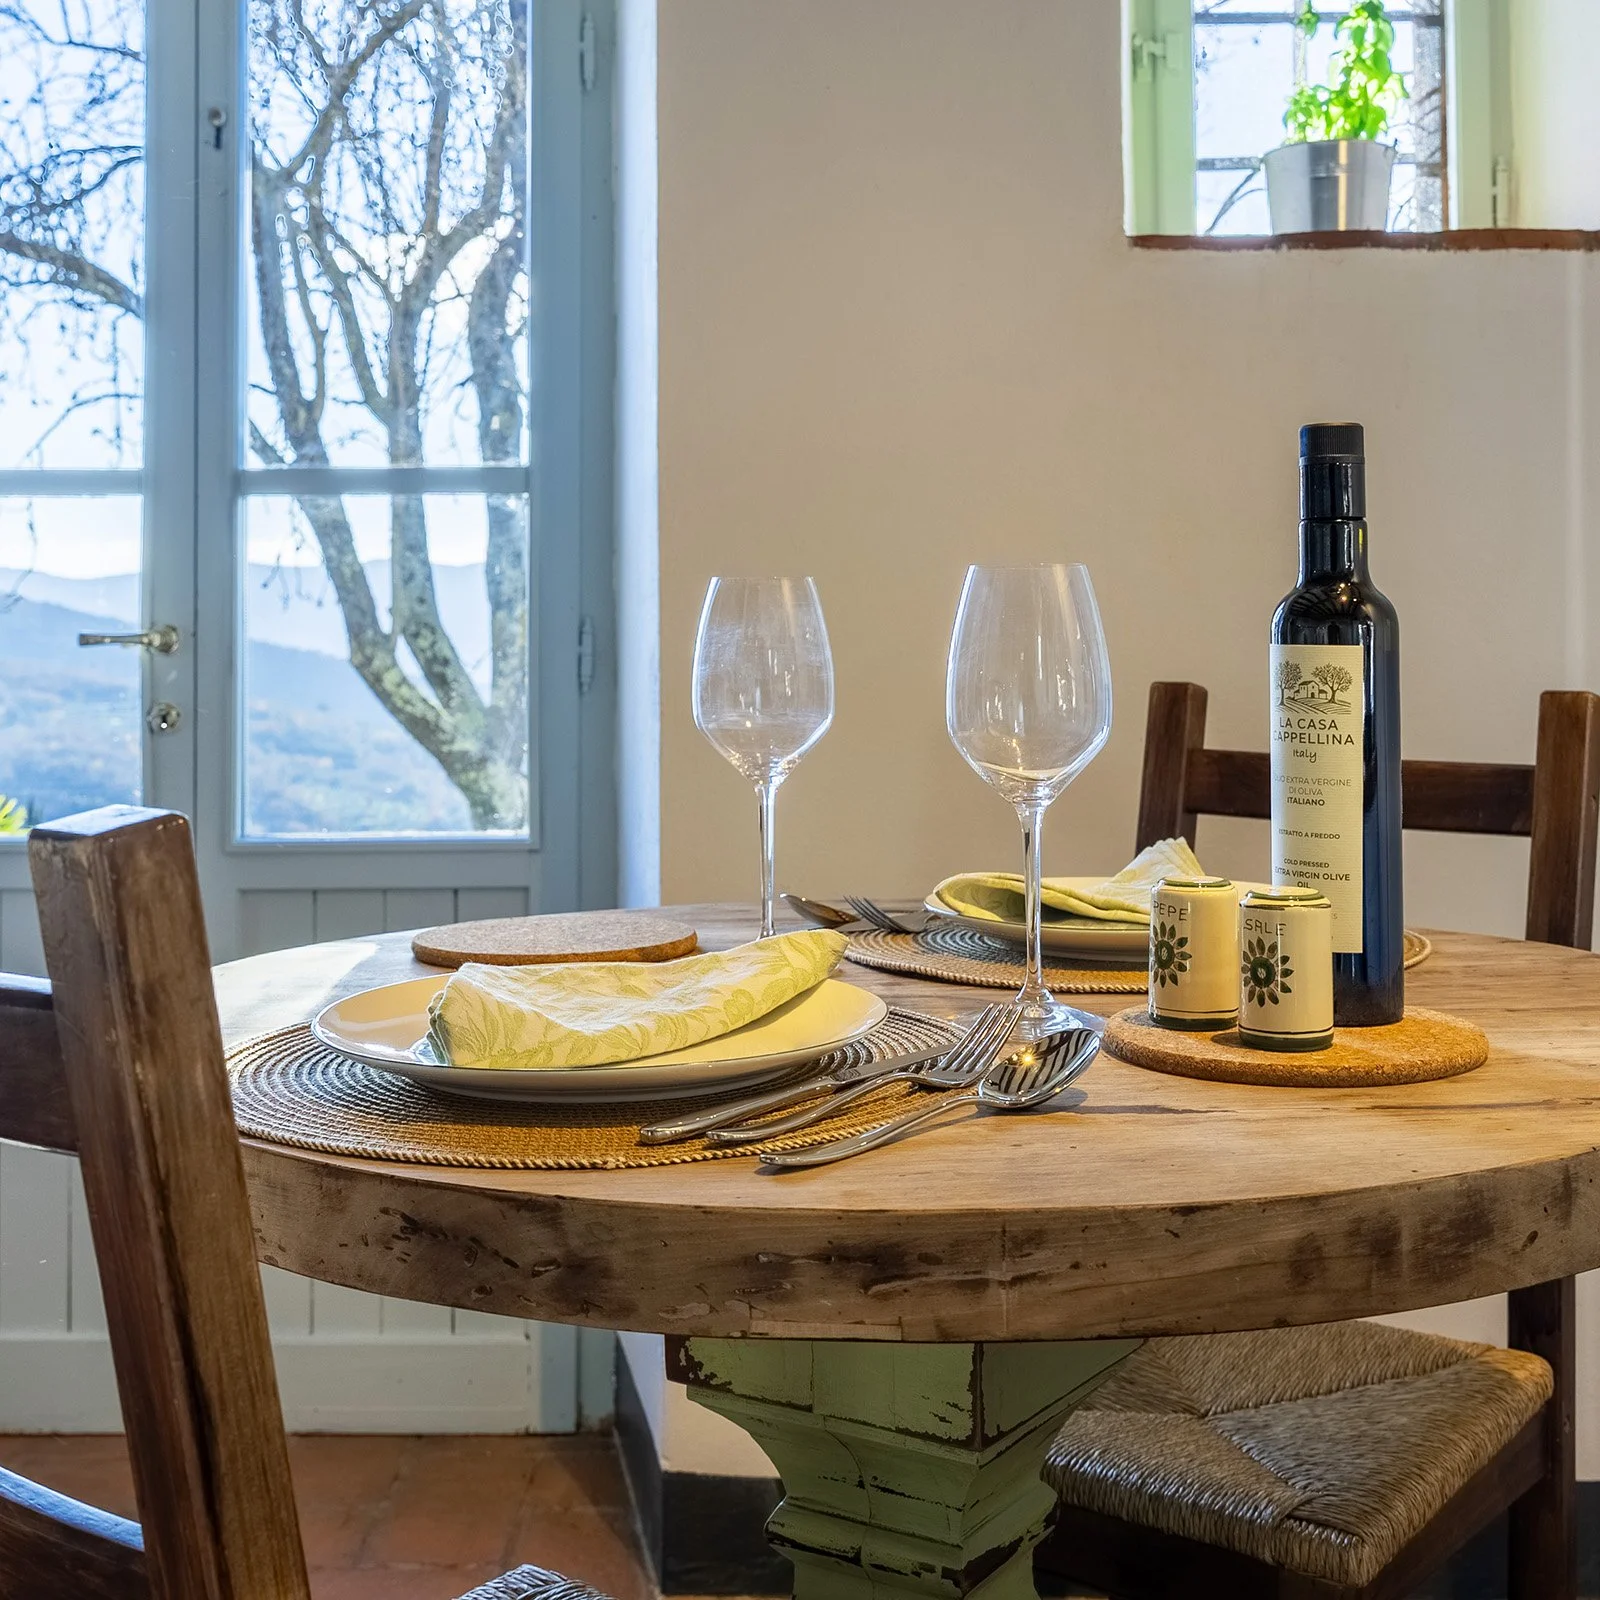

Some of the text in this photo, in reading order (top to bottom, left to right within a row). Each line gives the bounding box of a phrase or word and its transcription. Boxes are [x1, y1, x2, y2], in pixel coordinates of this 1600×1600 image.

[1279, 717, 1339, 731] LA CASA
[1292, 749, 1317, 763] Italy
[1286, 775, 1310, 786] EXTRA
[1311, 778, 1352, 787] VERGINE
[1288, 786, 1323, 796] DI OLIVA
[1286, 796, 1326, 807] ITALIANO
[1304, 831, 1310, 839] A
[1310, 832, 1341, 840] FREDDO
[1283, 857, 1330, 869] COLD PRESSED
[1291, 869, 1320, 880] VIRGIN
[1322, 872, 1351, 882] OLIVE
[1296, 881, 1311, 889] OIL
[1153, 900, 1188, 921] PEPE
[1244, 918, 1287, 936] SALE
